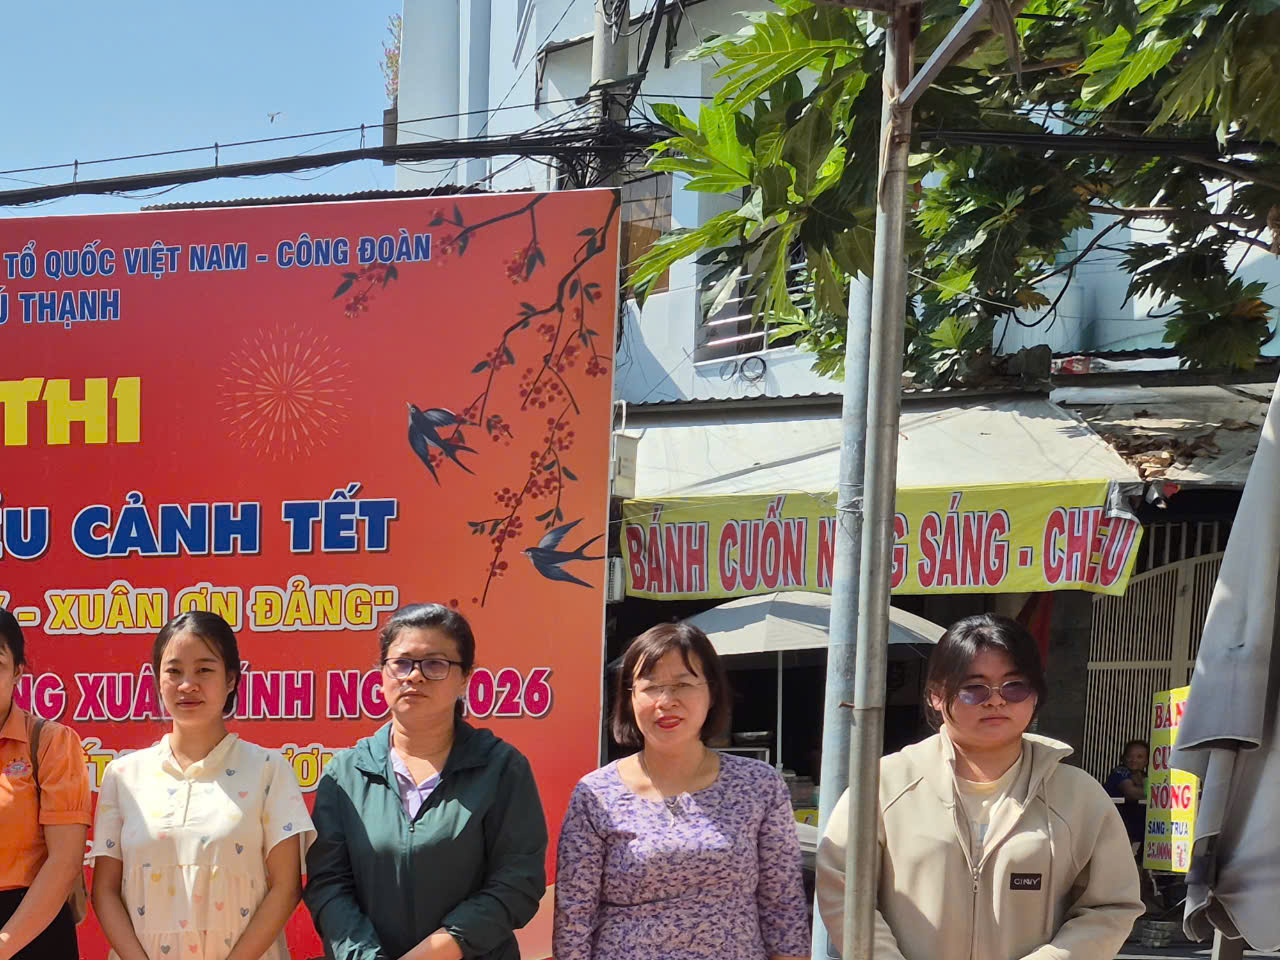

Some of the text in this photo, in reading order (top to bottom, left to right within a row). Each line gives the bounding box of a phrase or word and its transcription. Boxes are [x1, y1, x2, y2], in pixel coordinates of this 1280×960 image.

[4, 240, 37, 279] TỔ
[44, 239, 116, 280] QUỐC
[123, 240, 181, 279] VIỆT
[189, 242, 248, 272] NAM
[277, 232, 349, 268] CÔNG
[357, 228, 432, 264] ĐOÀN
[18, 288, 121, 329] THẠNH
[71, 490, 261, 558] CẢNH
[281, 482, 398, 552] TẾT
[625, 503, 710, 594] BÁNH
[718, 495, 808, 593] CUỐN
[917, 491, 1011, 589] SÁNG
[49, 586, 163, 630] XUÂN
[252, 580, 394, 628] ĐẢNG"
[73, 662, 166, 721] XUÂ
[226, 661, 314, 719] ÍNH
[327, 668, 390, 719] NG
[462, 667, 552, 718] 026
[1154, 696, 1187, 730] BÁN
[1150, 779, 1192, 810] NÓNG
